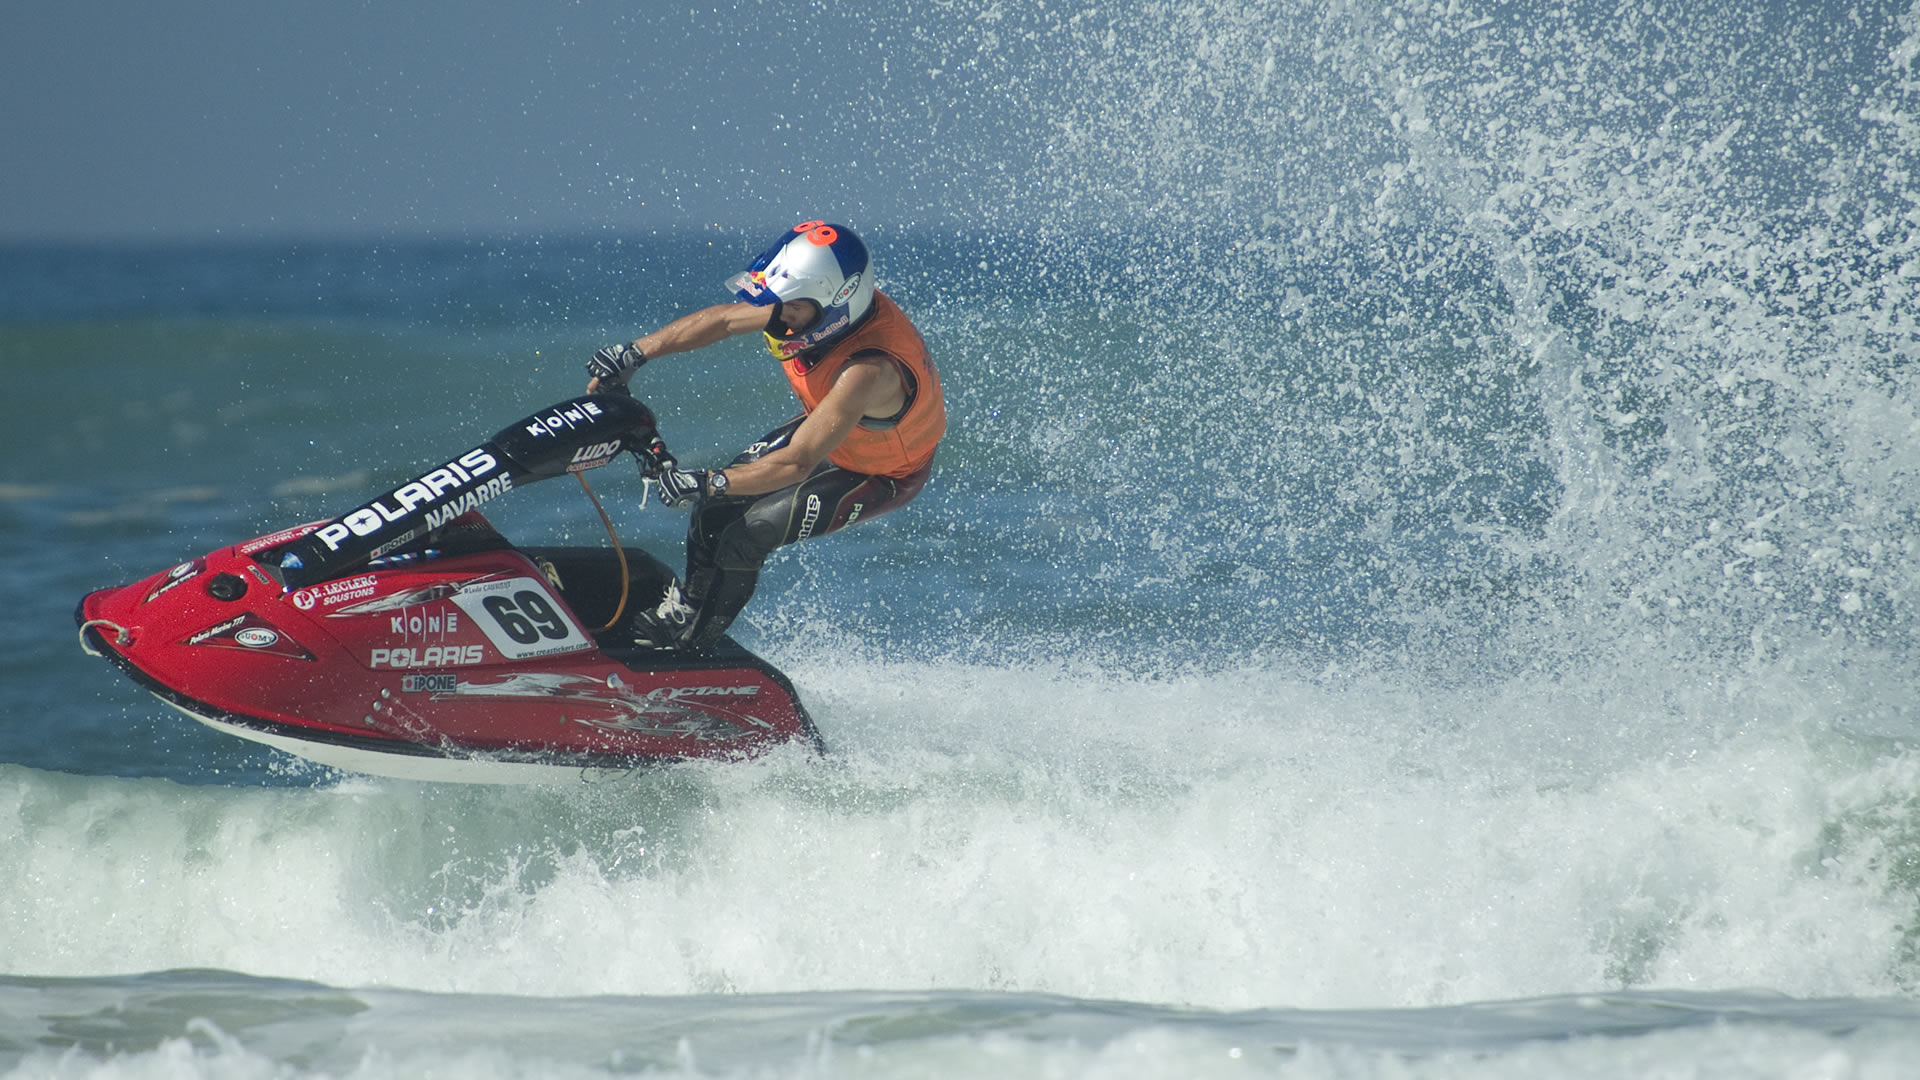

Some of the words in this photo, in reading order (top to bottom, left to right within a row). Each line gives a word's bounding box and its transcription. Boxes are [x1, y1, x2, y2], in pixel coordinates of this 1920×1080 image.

[526, 402, 603, 437] KONE
[571, 439, 621, 463] LUDO
[315, 448, 497, 551] POLARIS
[424, 471, 513, 531] NAVARRE
[323, 587, 375, 606] SOUSTONS
[391, 612, 458, 634] KONE
[482, 590, 569, 644] 69
[371, 645, 483, 669] POLARIS
